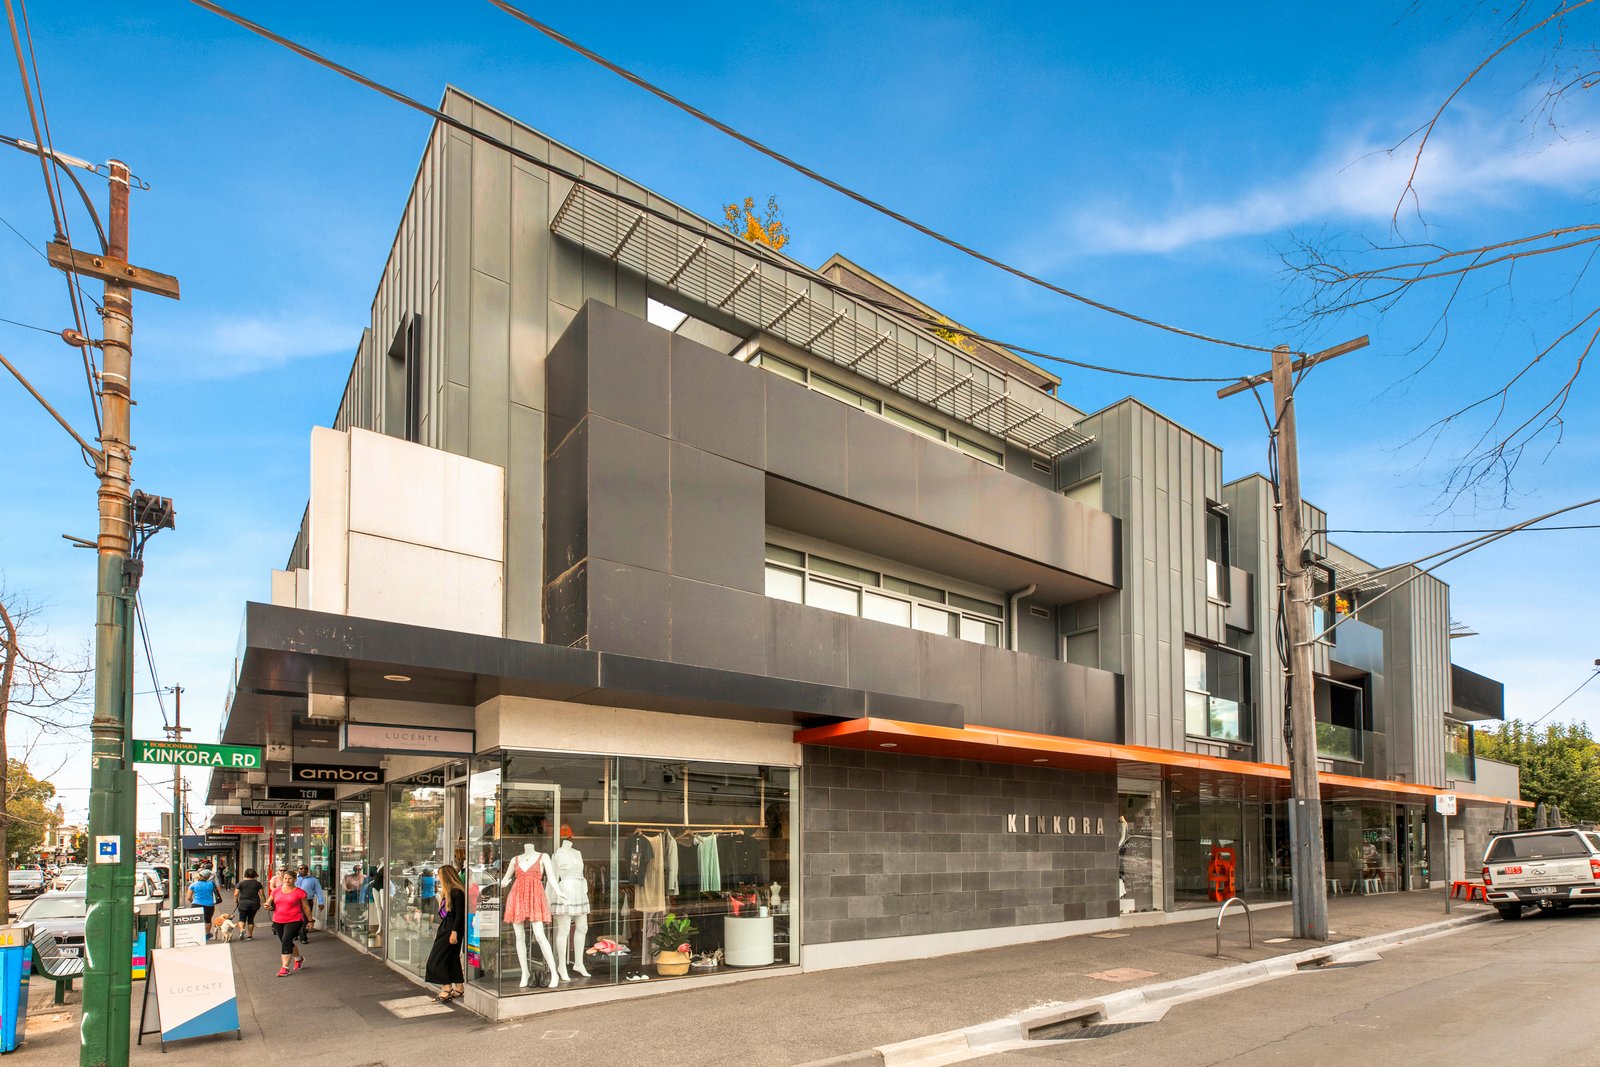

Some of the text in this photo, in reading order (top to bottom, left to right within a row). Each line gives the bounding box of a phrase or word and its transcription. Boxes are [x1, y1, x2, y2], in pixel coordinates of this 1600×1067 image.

[385, 732, 440, 742] LUCENTE
[149, 741, 198, 750] BOROONDARA
[143, 748, 256, 767] KINKORA RD
[299, 768, 378, 781] ambra
[279, 801, 303, 809] Nails
[1007, 814, 1104, 834] KINKORA
[170, 982, 224, 995] LUCENTE
